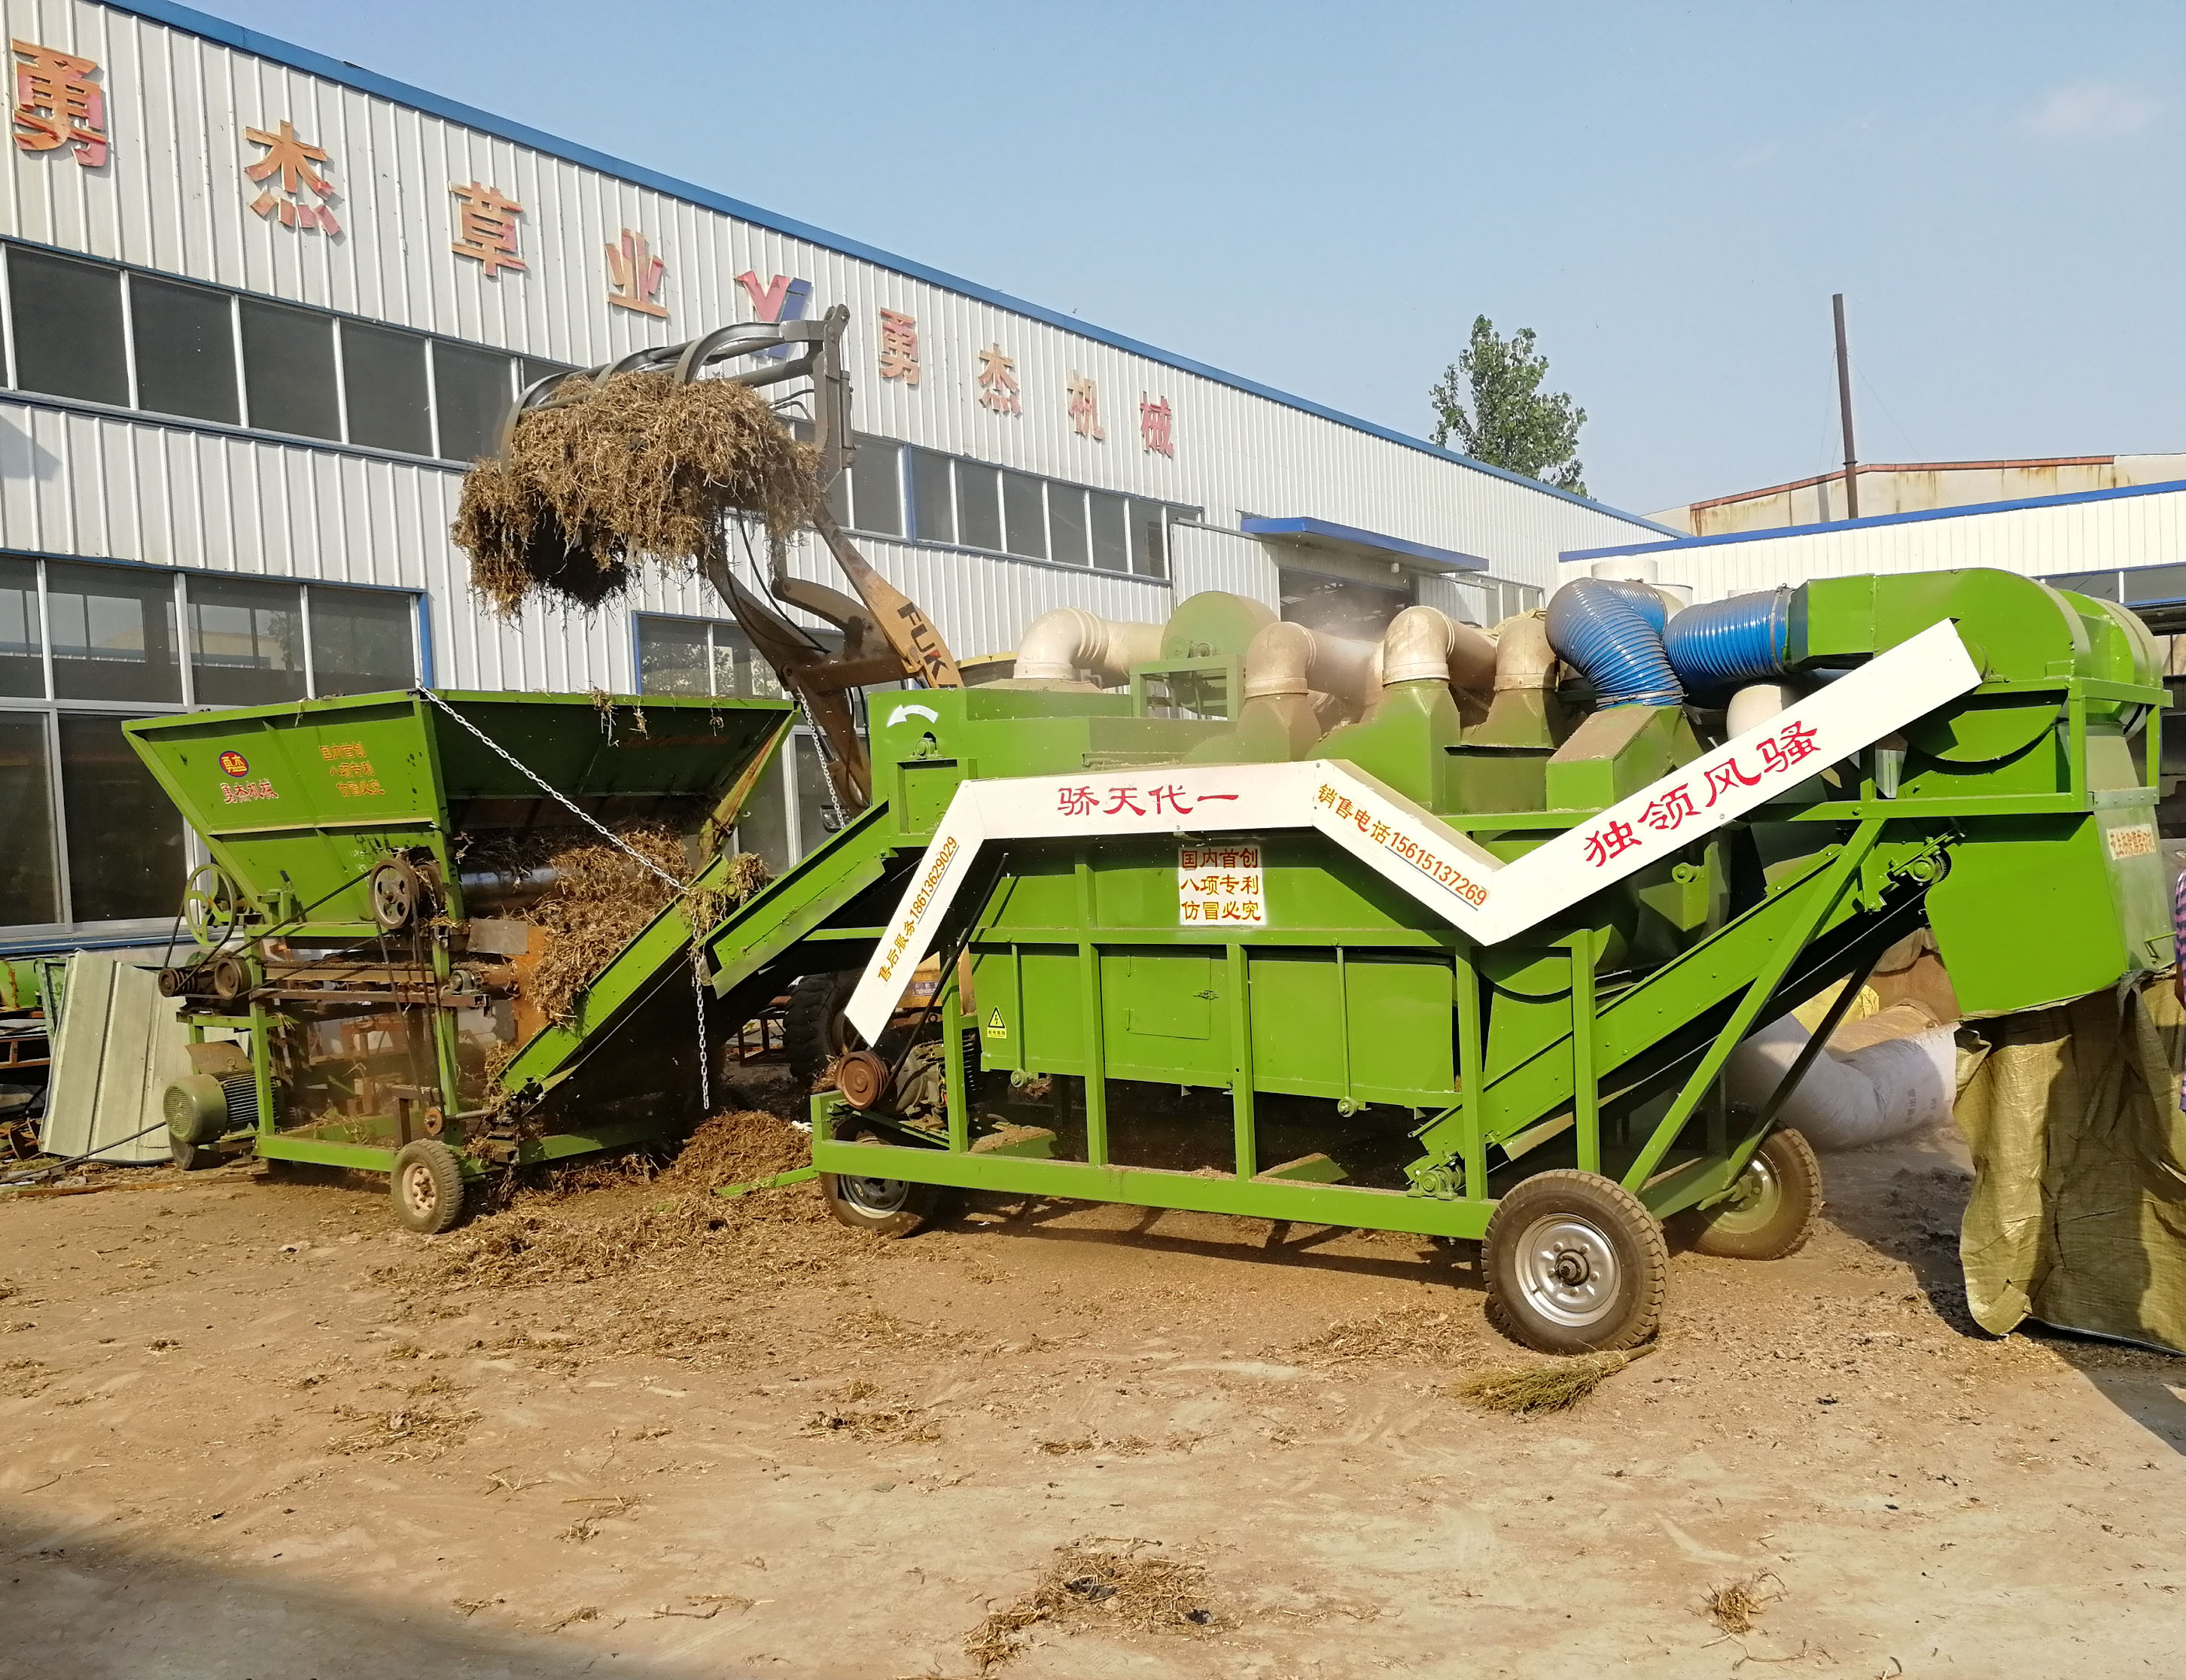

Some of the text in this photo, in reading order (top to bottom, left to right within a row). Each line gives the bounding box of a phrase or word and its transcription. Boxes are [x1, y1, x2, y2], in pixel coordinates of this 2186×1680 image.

[11, 38, 669, 318] 勇杰草业
[881, 309, 1174, 458] 勇杰机械
[897, 601, 958, 689] FUK
[1584, 720, 1822, 867] 独领风骚
[1180, 874, 1259, 896] 八项专利
[1181, 848, 1259, 869] 国内首创
[1181, 900, 1262, 921] 仿冒必究
